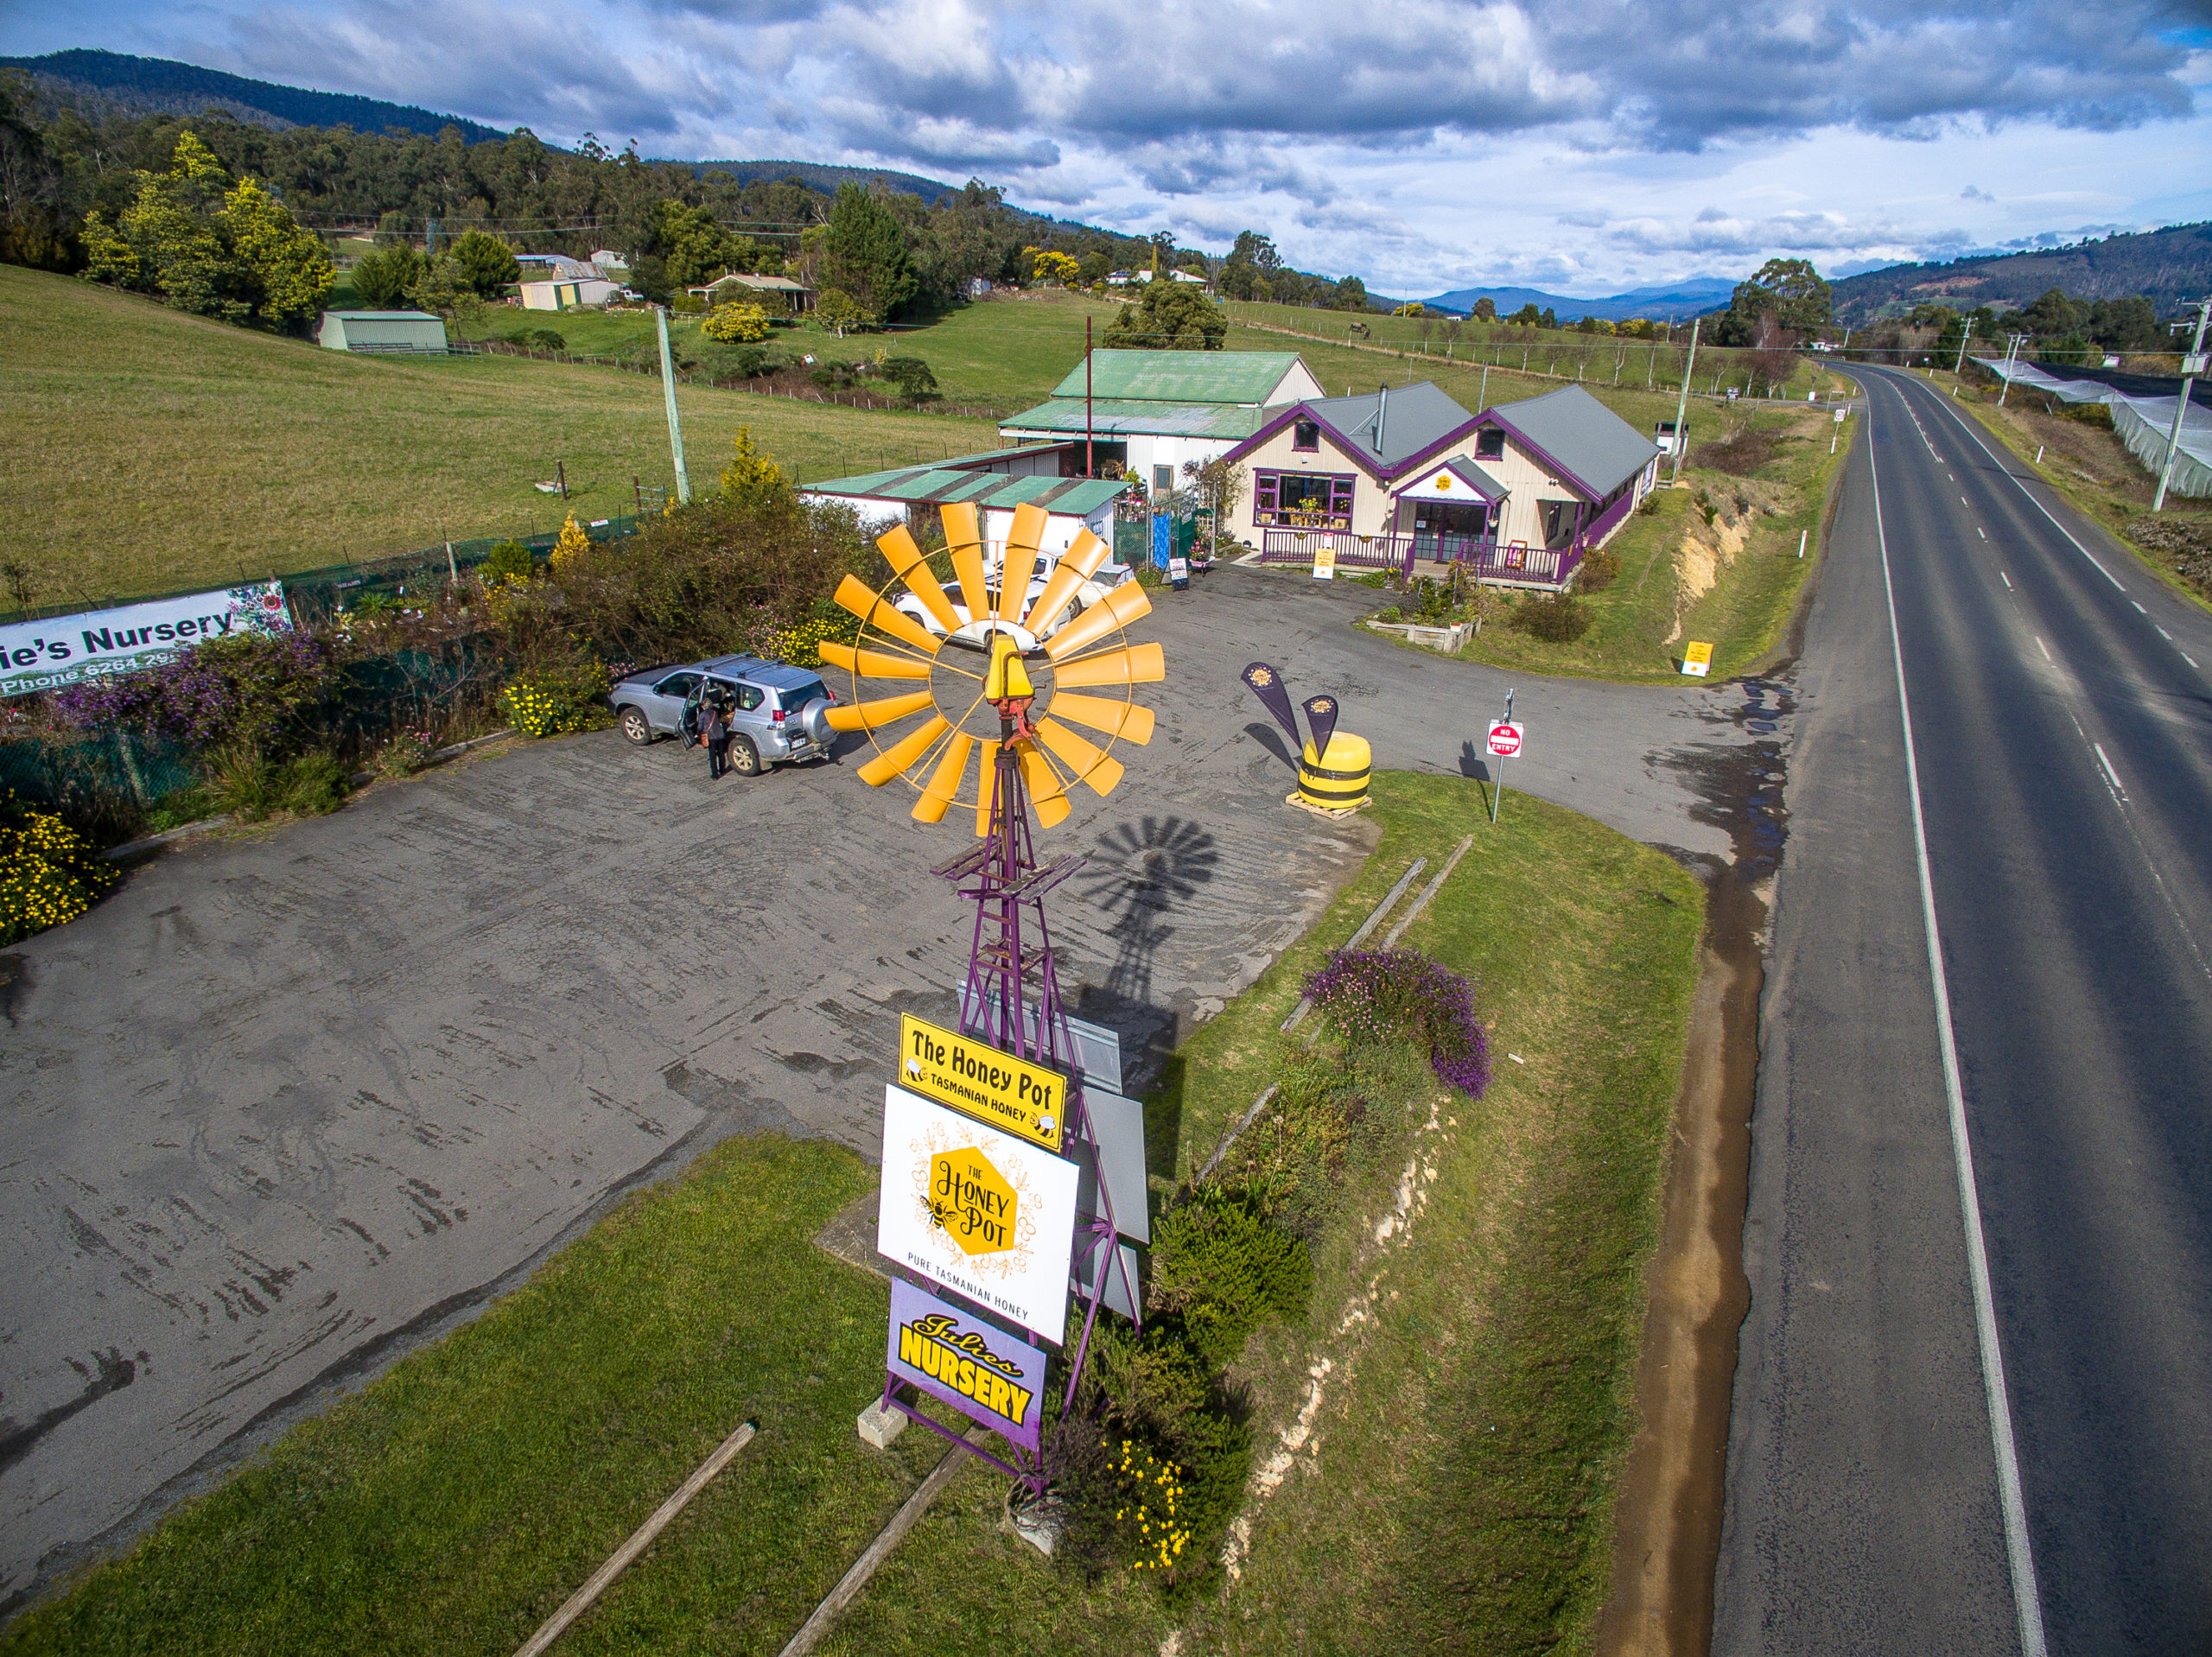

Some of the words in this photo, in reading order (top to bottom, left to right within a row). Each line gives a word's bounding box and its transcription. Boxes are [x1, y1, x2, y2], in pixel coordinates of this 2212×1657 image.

[81, 613, 232, 654] Nursery
[1, 670, 79, 693] Phone
[85, 657, 141, 676] 6264
[912, 1030, 945, 1066] The
[952, 1046, 1012, 1091] Honey
[1018, 1073, 1052, 1110] Pot
[931, 1073, 988, 1107] TASMANIAN
[991, 1098, 1027, 1122] HONEY
[937, 1160, 1009, 1218] HONEY
[968, 1165, 983, 1181] THE
[960, 1206, 1007, 1248] POT
[907, 1252, 931, 1273] PURE
[936, 1266, 990, 1302] TASMANIAN
[995, 1296, 1028, 1320] HONEY
[912, 1314, 1024, 1377] Julies
[899, 1323, 1033, 1427] NURSERY
